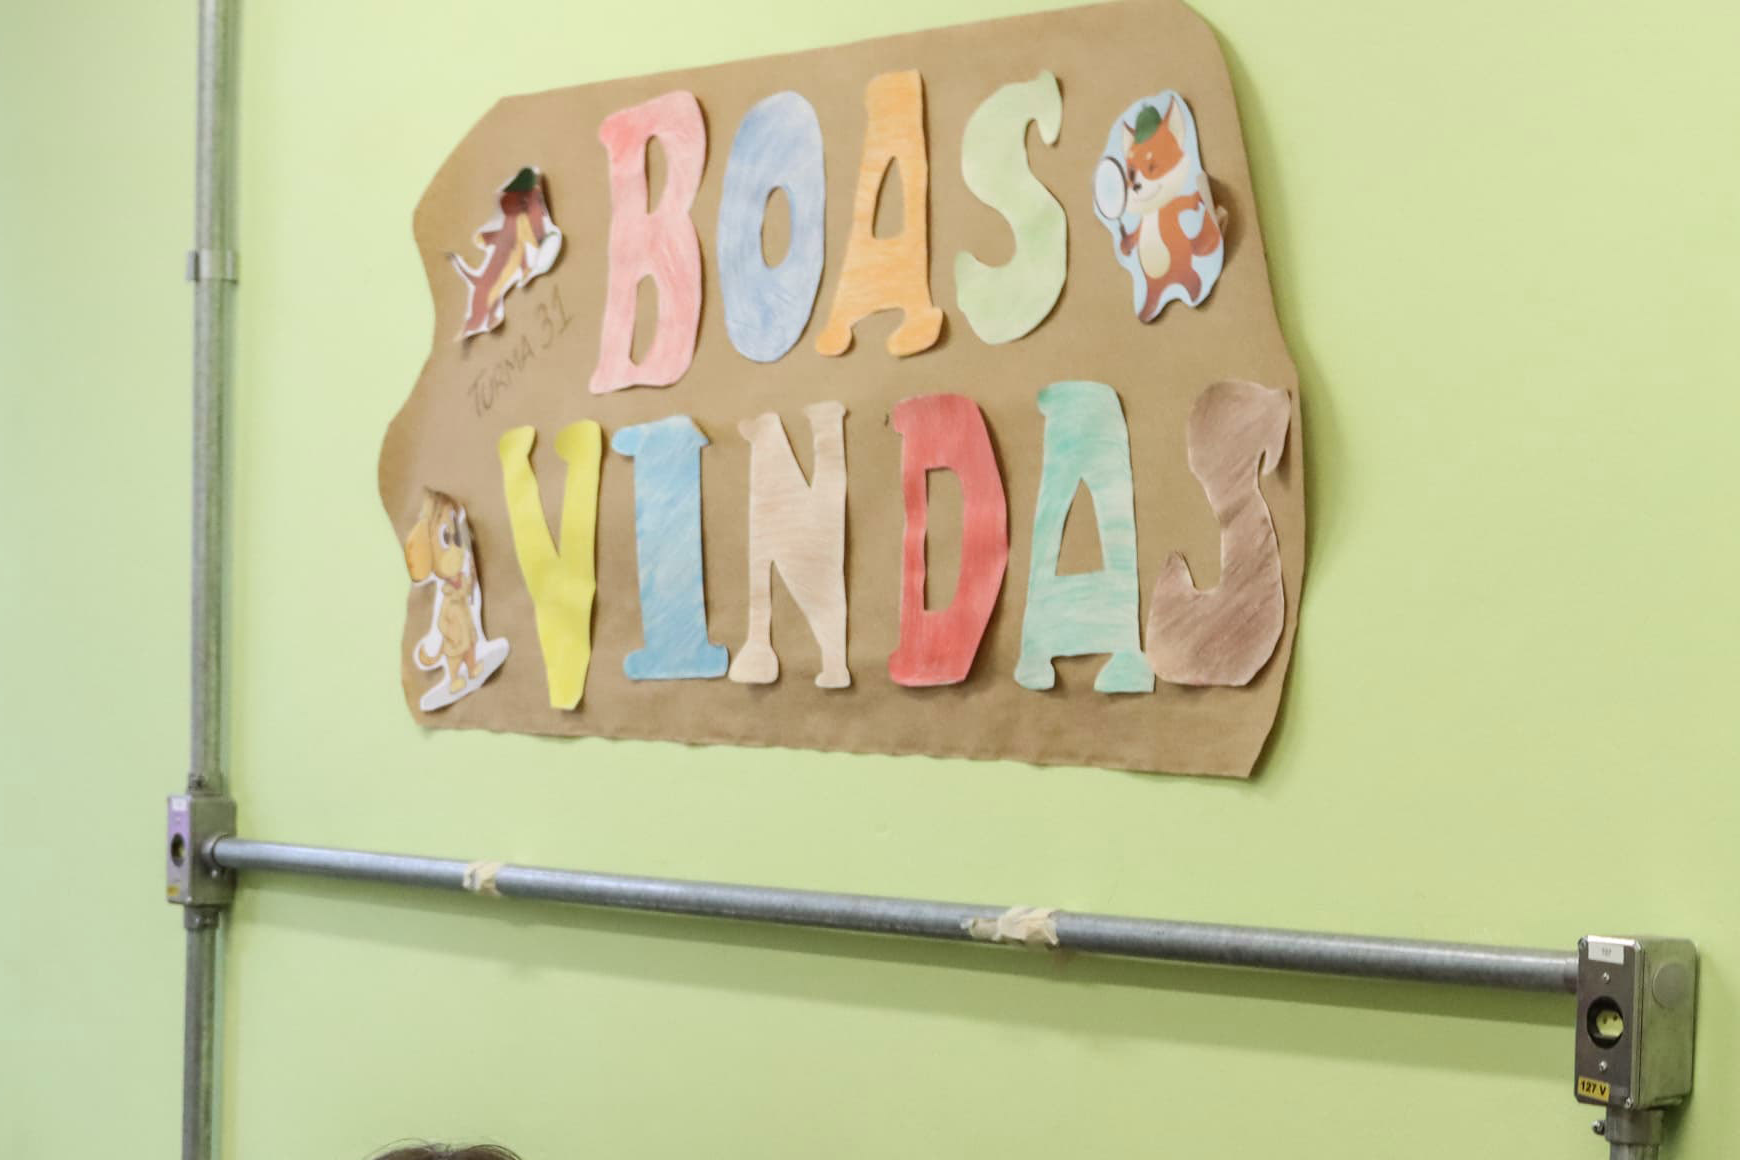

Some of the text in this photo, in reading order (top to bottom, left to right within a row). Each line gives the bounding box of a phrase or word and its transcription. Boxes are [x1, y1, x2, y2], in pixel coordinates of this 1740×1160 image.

[590, 69, 1067, 394] BOAS
[498, 380, 1291, 710] VINDAS
[1581, 1080, 1607, 1096] 127 V
